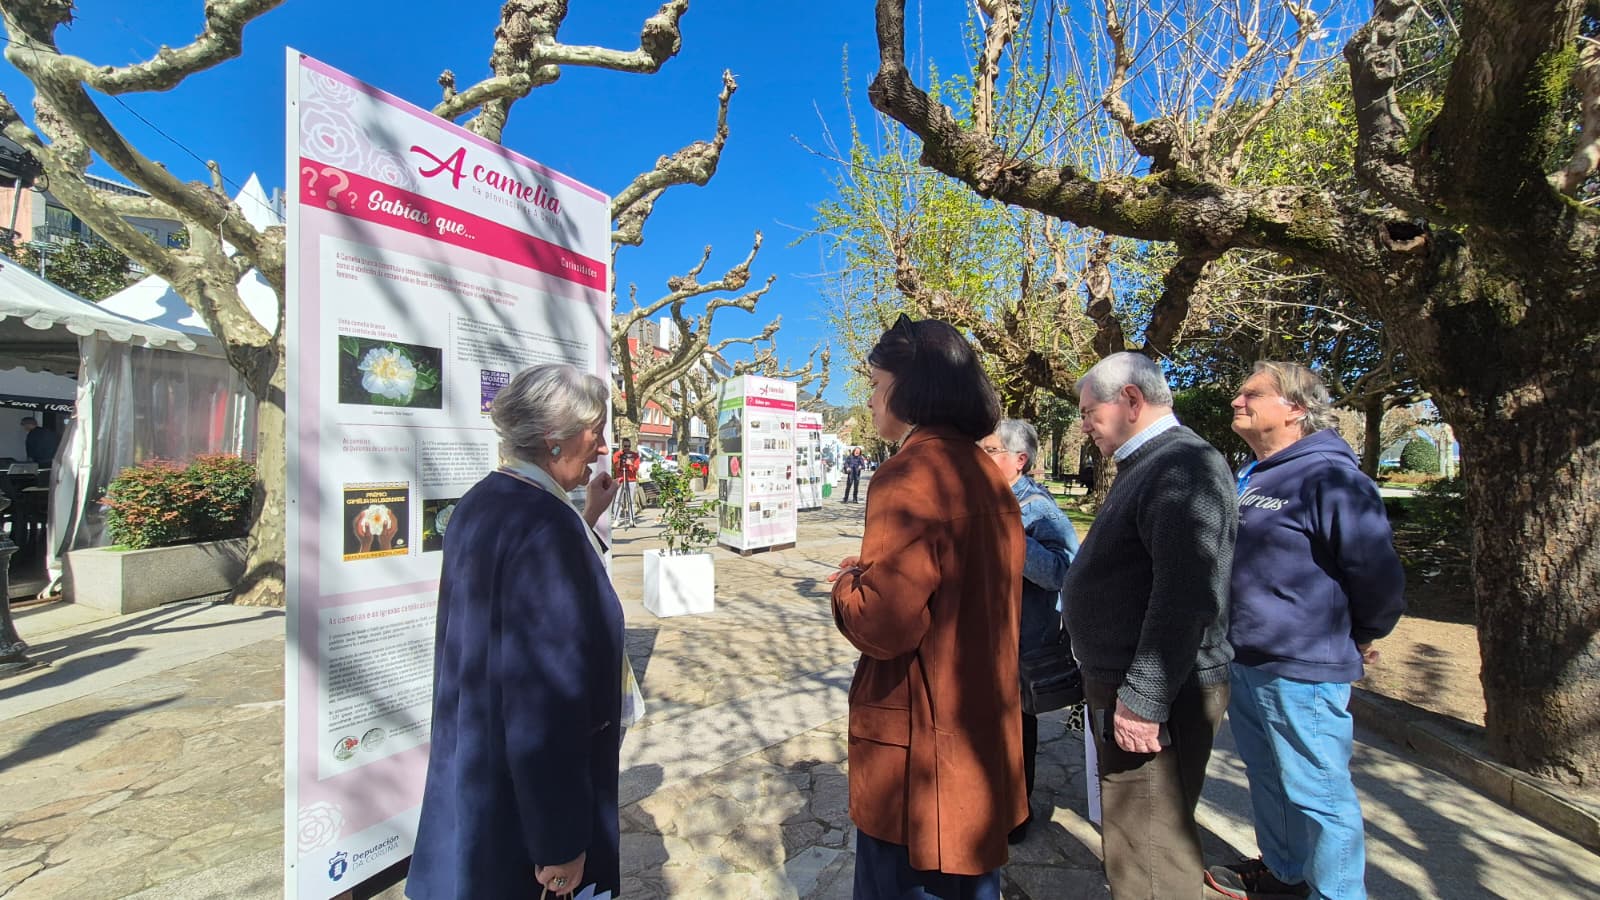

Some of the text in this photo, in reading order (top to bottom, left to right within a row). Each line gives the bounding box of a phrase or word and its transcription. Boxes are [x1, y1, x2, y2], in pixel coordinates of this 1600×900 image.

[410, 145, 562, 215] A camelia
[367, 190, 476, 240] Sabías que...
[560, 256, 598, 279] Curiosidades
[352, 834, 399, 863] Deputación
